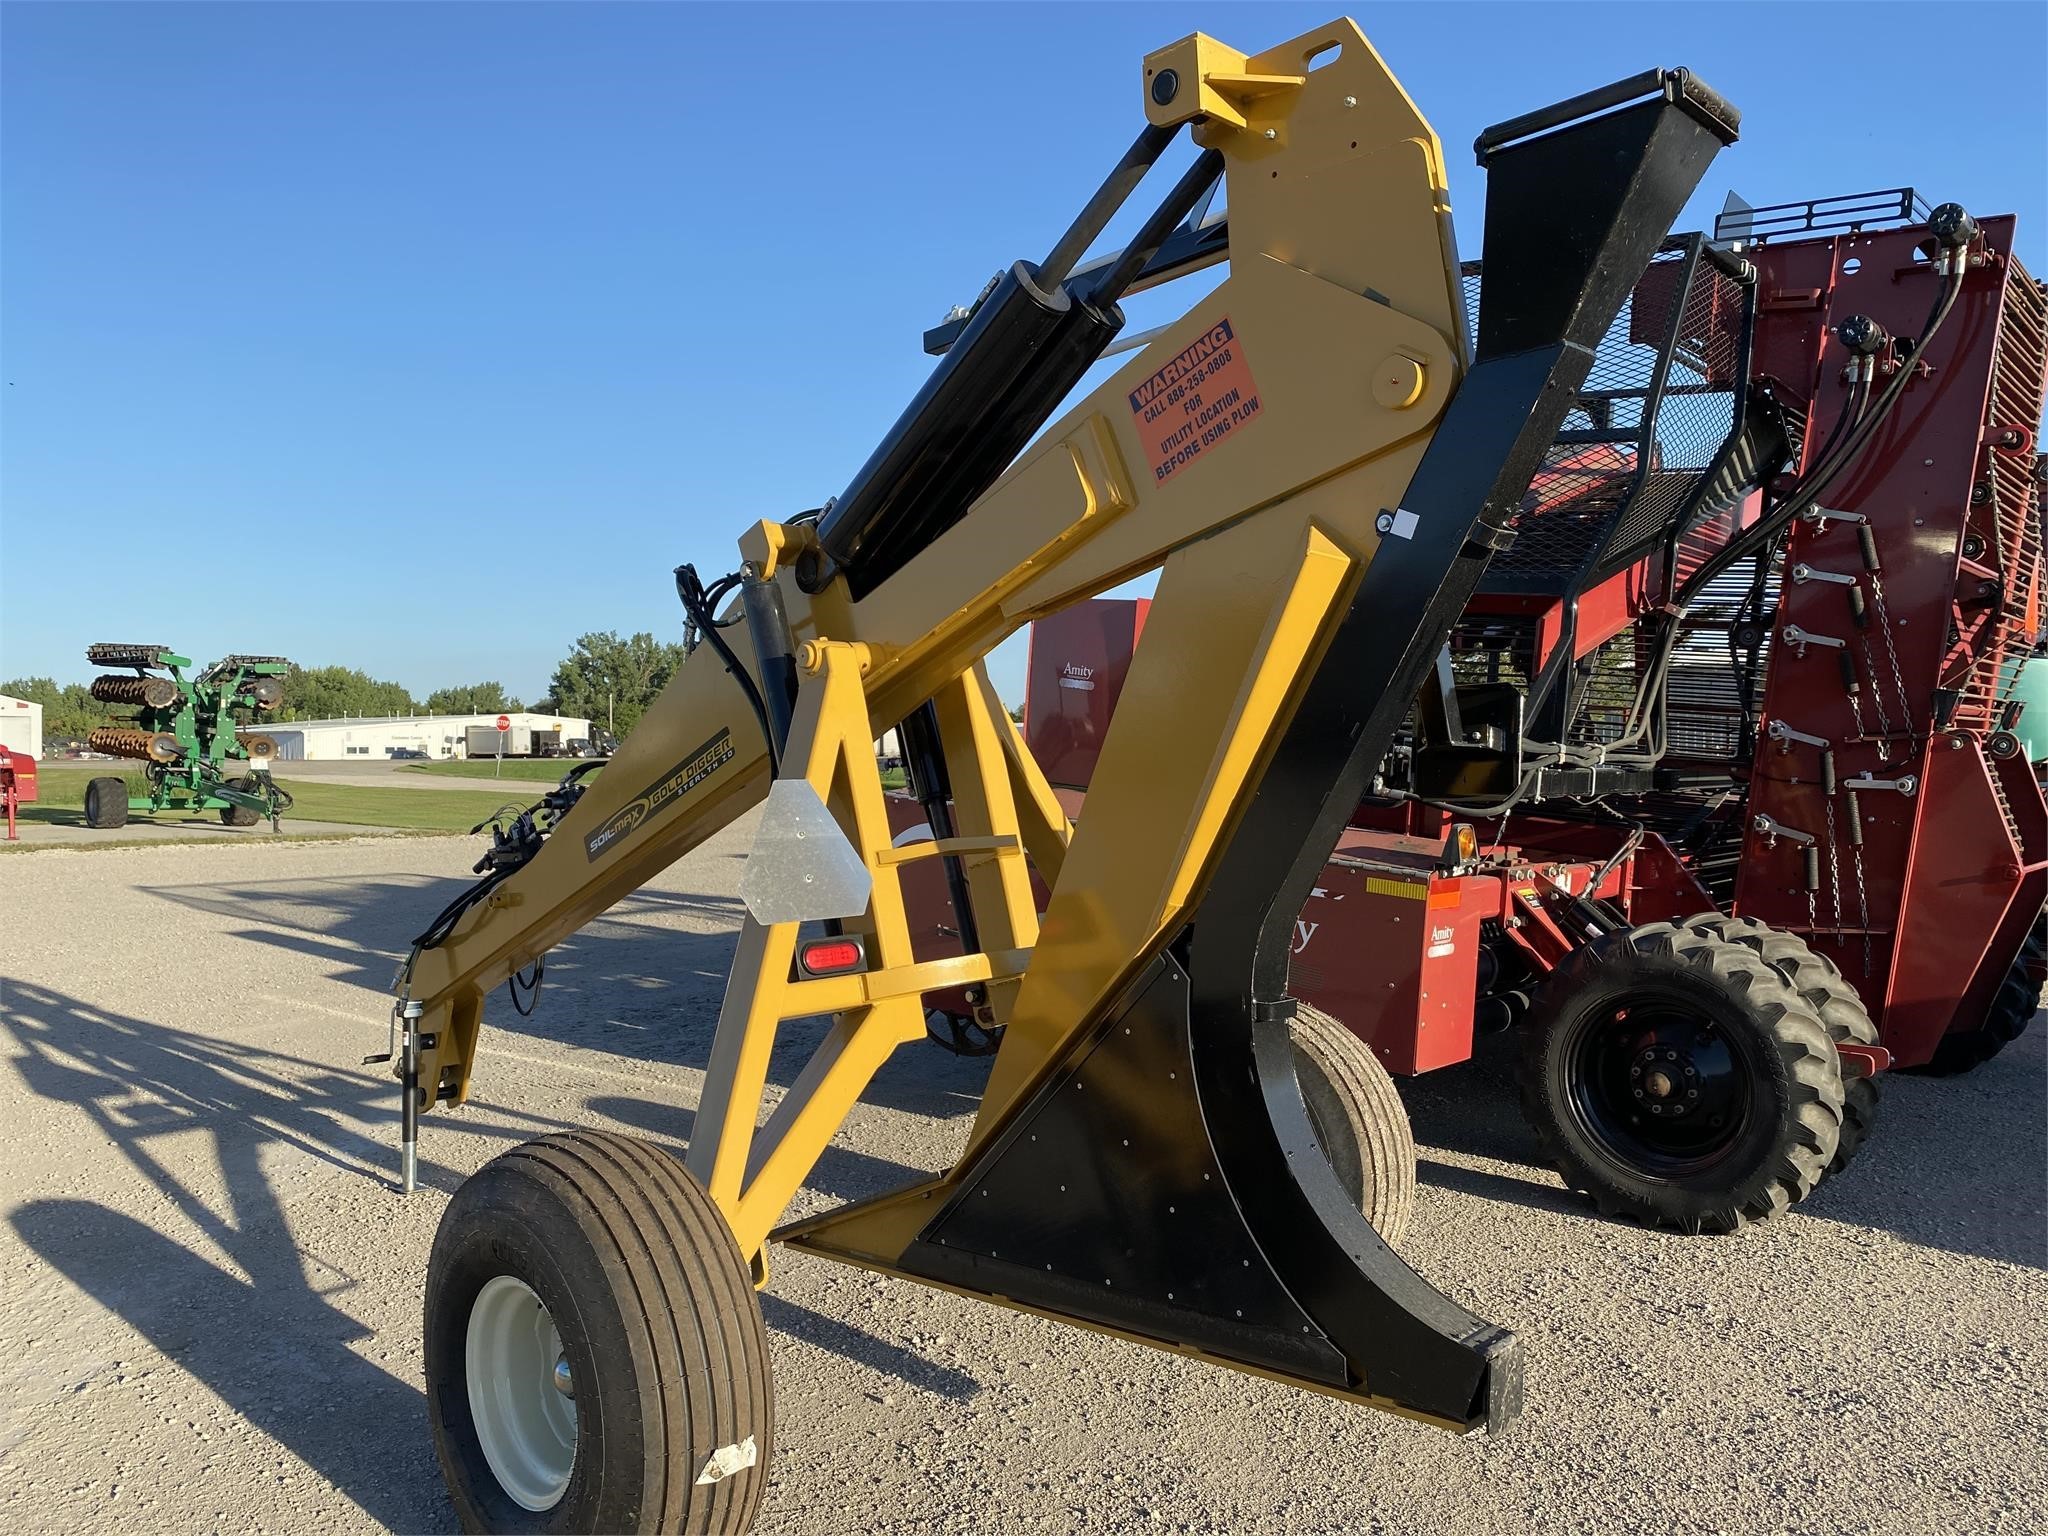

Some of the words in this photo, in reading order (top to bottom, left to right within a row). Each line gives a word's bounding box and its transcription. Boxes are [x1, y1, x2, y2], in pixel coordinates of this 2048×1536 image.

[1136, 327, 1228, 404] WARNING
[1144, 402, 1167, 423] CALL
[1167, 349, 1232, 406] 888-258-0808
[1161, 421, 1194, 454] UTILITY
[1197, 387, 1240, 430] LOCATION
[1184, 394, 1203, 415] FOR
[1156, 440, 1201, 480] BEFORE
[1202, 417, 1231, 447] USING
[1232, 396, 1260, 425] PLOW
[1063, 661, 1093, 680] Amity
[497, 719, 510, 727] STOP
[652, 775, 684, 806] GOLD
[686, 739, 731, 780] DIGGER
[677, 762, 719, 796] STEALTH
[1431, 925, 1455, 943] Amity
